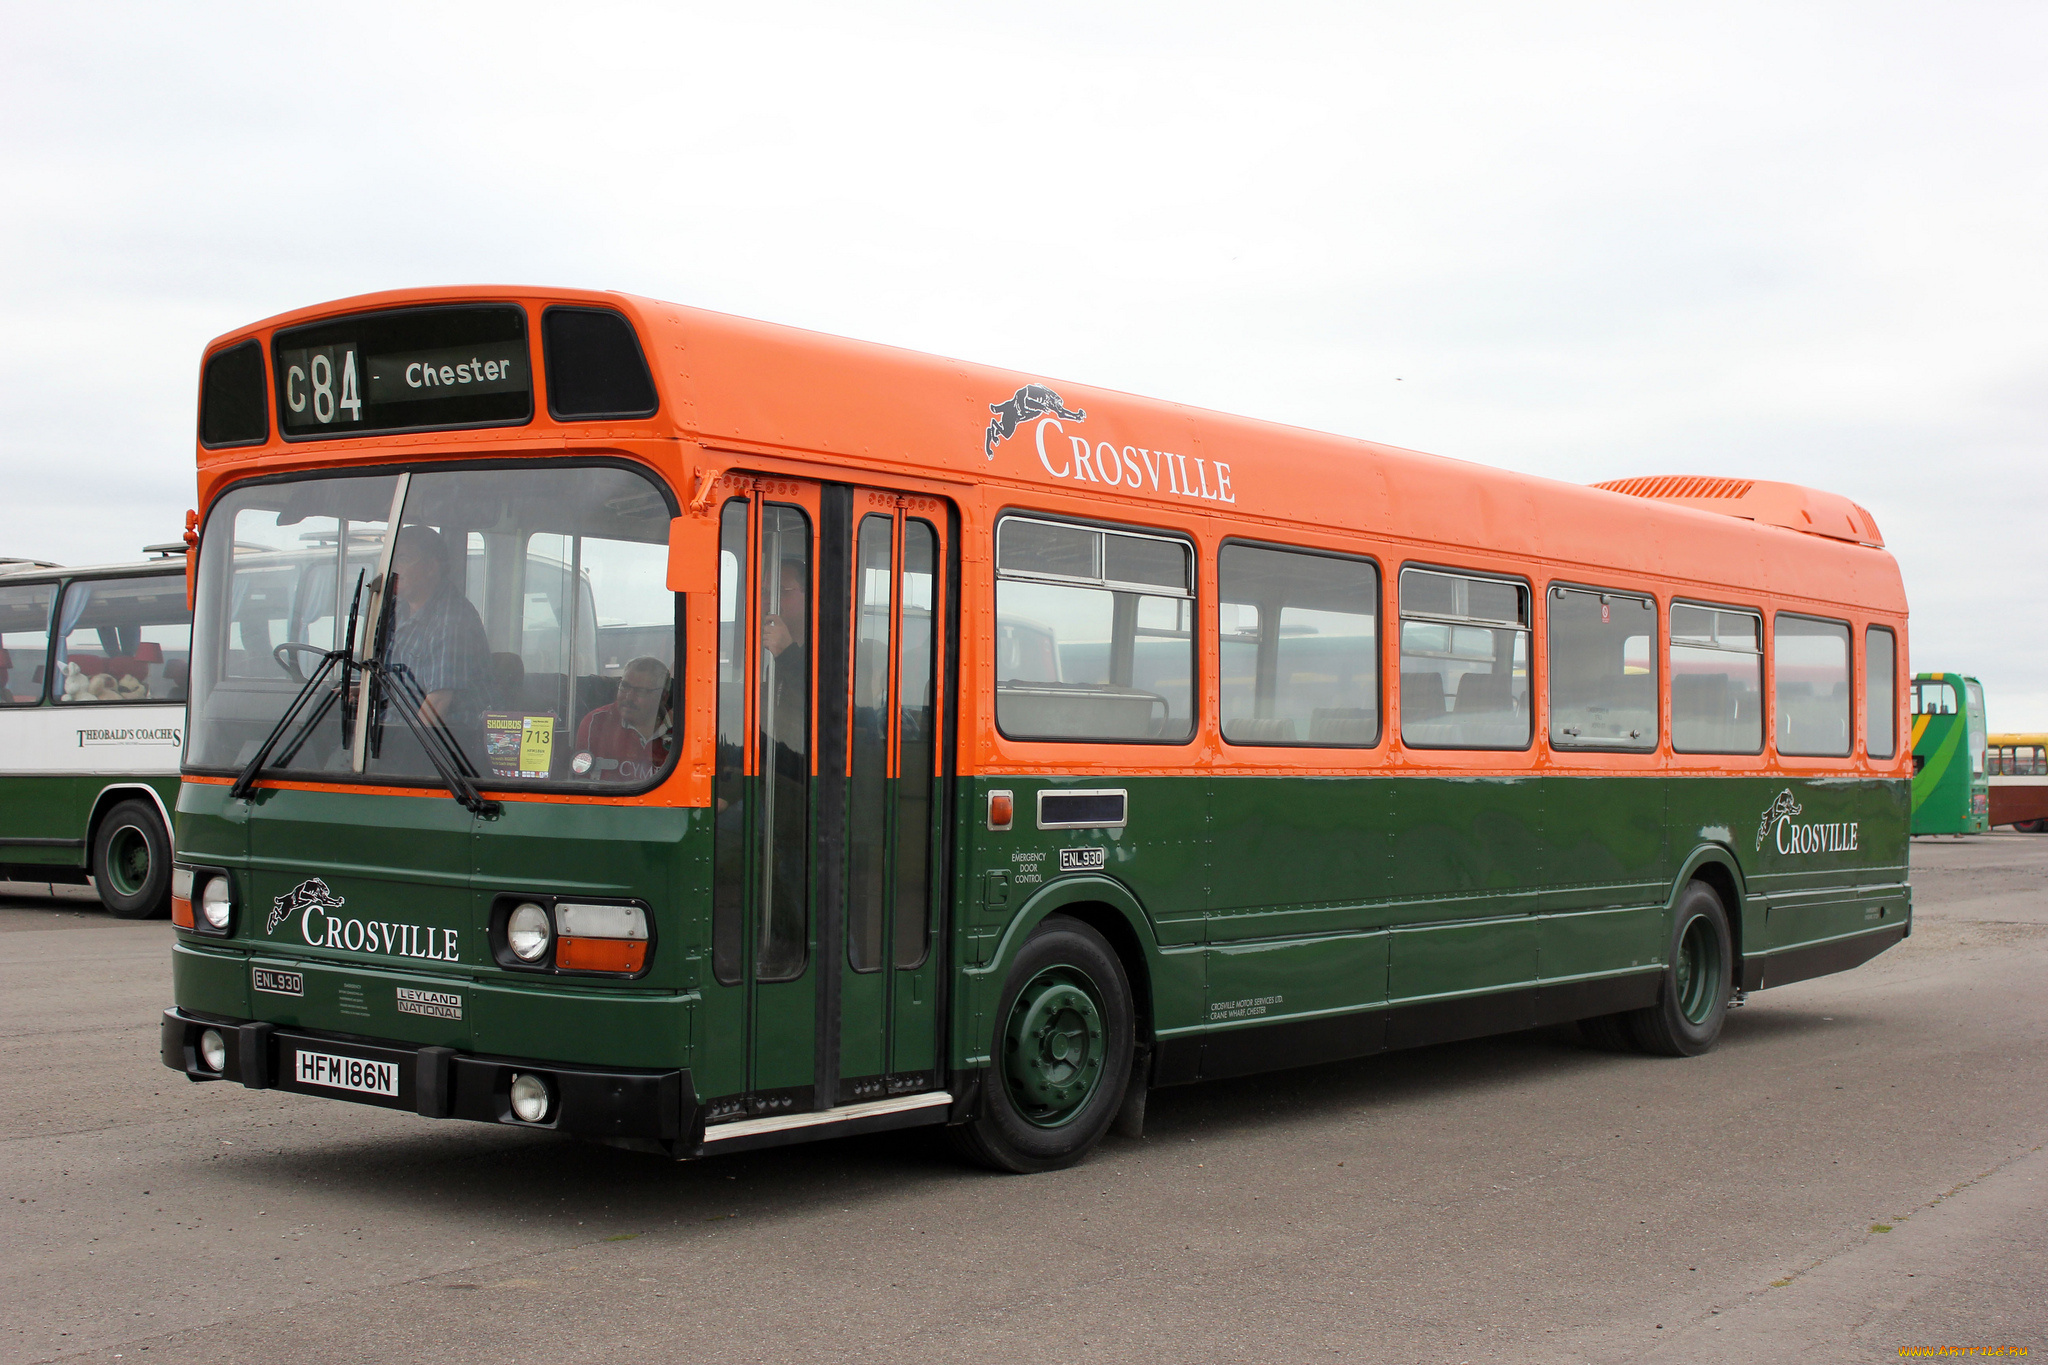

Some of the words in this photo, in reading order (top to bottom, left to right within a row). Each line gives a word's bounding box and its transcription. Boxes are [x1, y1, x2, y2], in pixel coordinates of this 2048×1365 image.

[405, 357, 510, 388] Chester
[1035, 417, 1235, 503] CROSVILLE
[487, 719, 521, 729] SHOWBUS
[77, 728, 134, 747] THEOBALD'S
[136, 728, 181, 747] COACHES
[526, 730, 550, 744] 713
[1776, 815, 1858, 855] CROSVILLE
[1011, 852, 1046, 862] EMERGENCY
[1020, 864, 1038, 873] DOOR
[1015, 874, 1042, 884] CONTROL
[301, 904, 459, 962] CROSVILLE
[255, 970, 300, 991] ENL930
[400, 990, 459, 1006] LEYLAND
[1211, 1001, 1235, 1011] CROSVILLE
[1236, 999, 1253, 1009] MOTOR
[1254, 996, 1274, 1006] SERVICES
[399, 1001, 461, 1019] NATIONAL
[1210, 1010, 1228, 1020] CRANE
[1246, 1006, 1266, 1016] CHESTER
